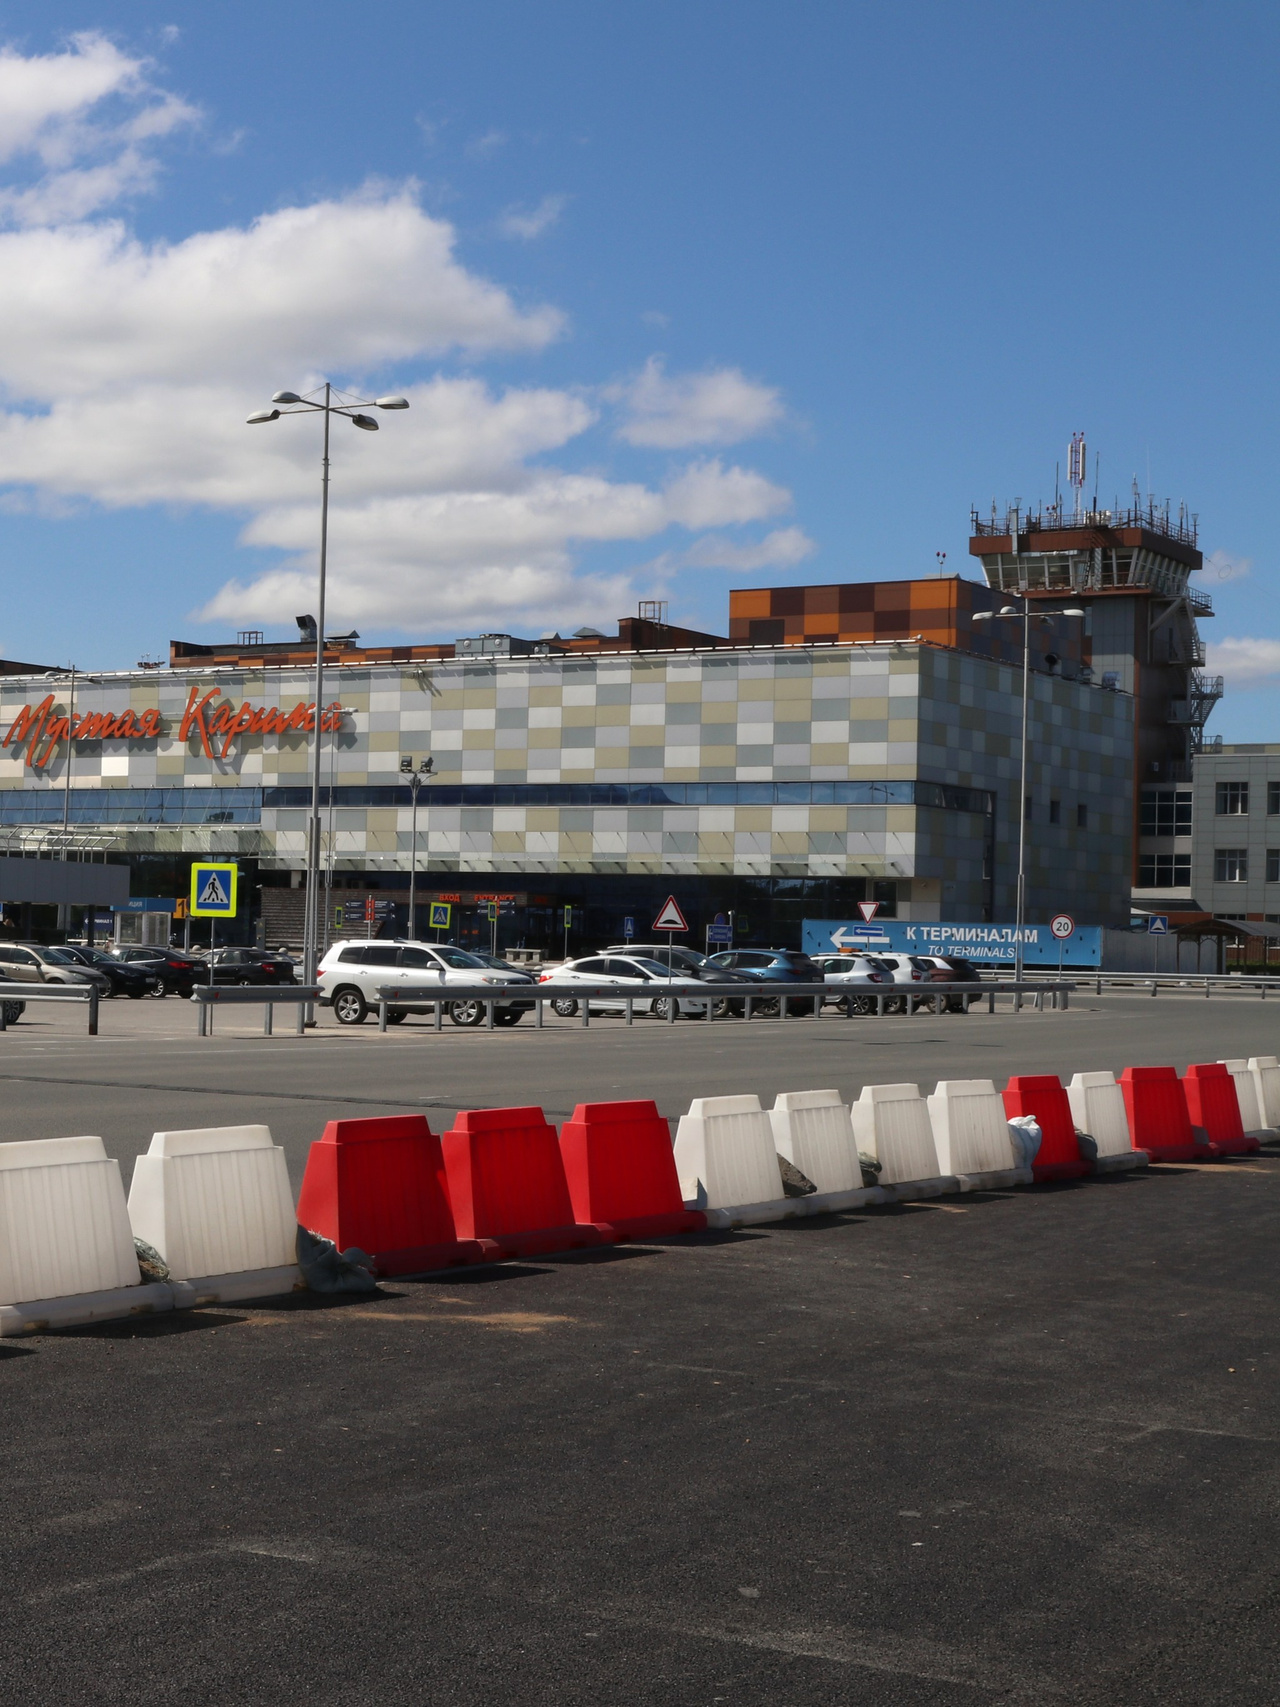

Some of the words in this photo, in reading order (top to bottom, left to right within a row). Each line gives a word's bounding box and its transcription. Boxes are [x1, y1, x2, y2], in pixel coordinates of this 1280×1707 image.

[2, 693, 162, 768] Мустая
[178, 686, 343, 760] Карима
[439, 893, 460, 902] ВХОД
[1055, 921, 1069, 932] 20
[906, 926, 917, 940] К
[920, 927, 1038, 943] ТЕРМИНАЛАМ
[928, 945, 944, 957] TO
[947, 946, 1015, 958] TERMINALS
